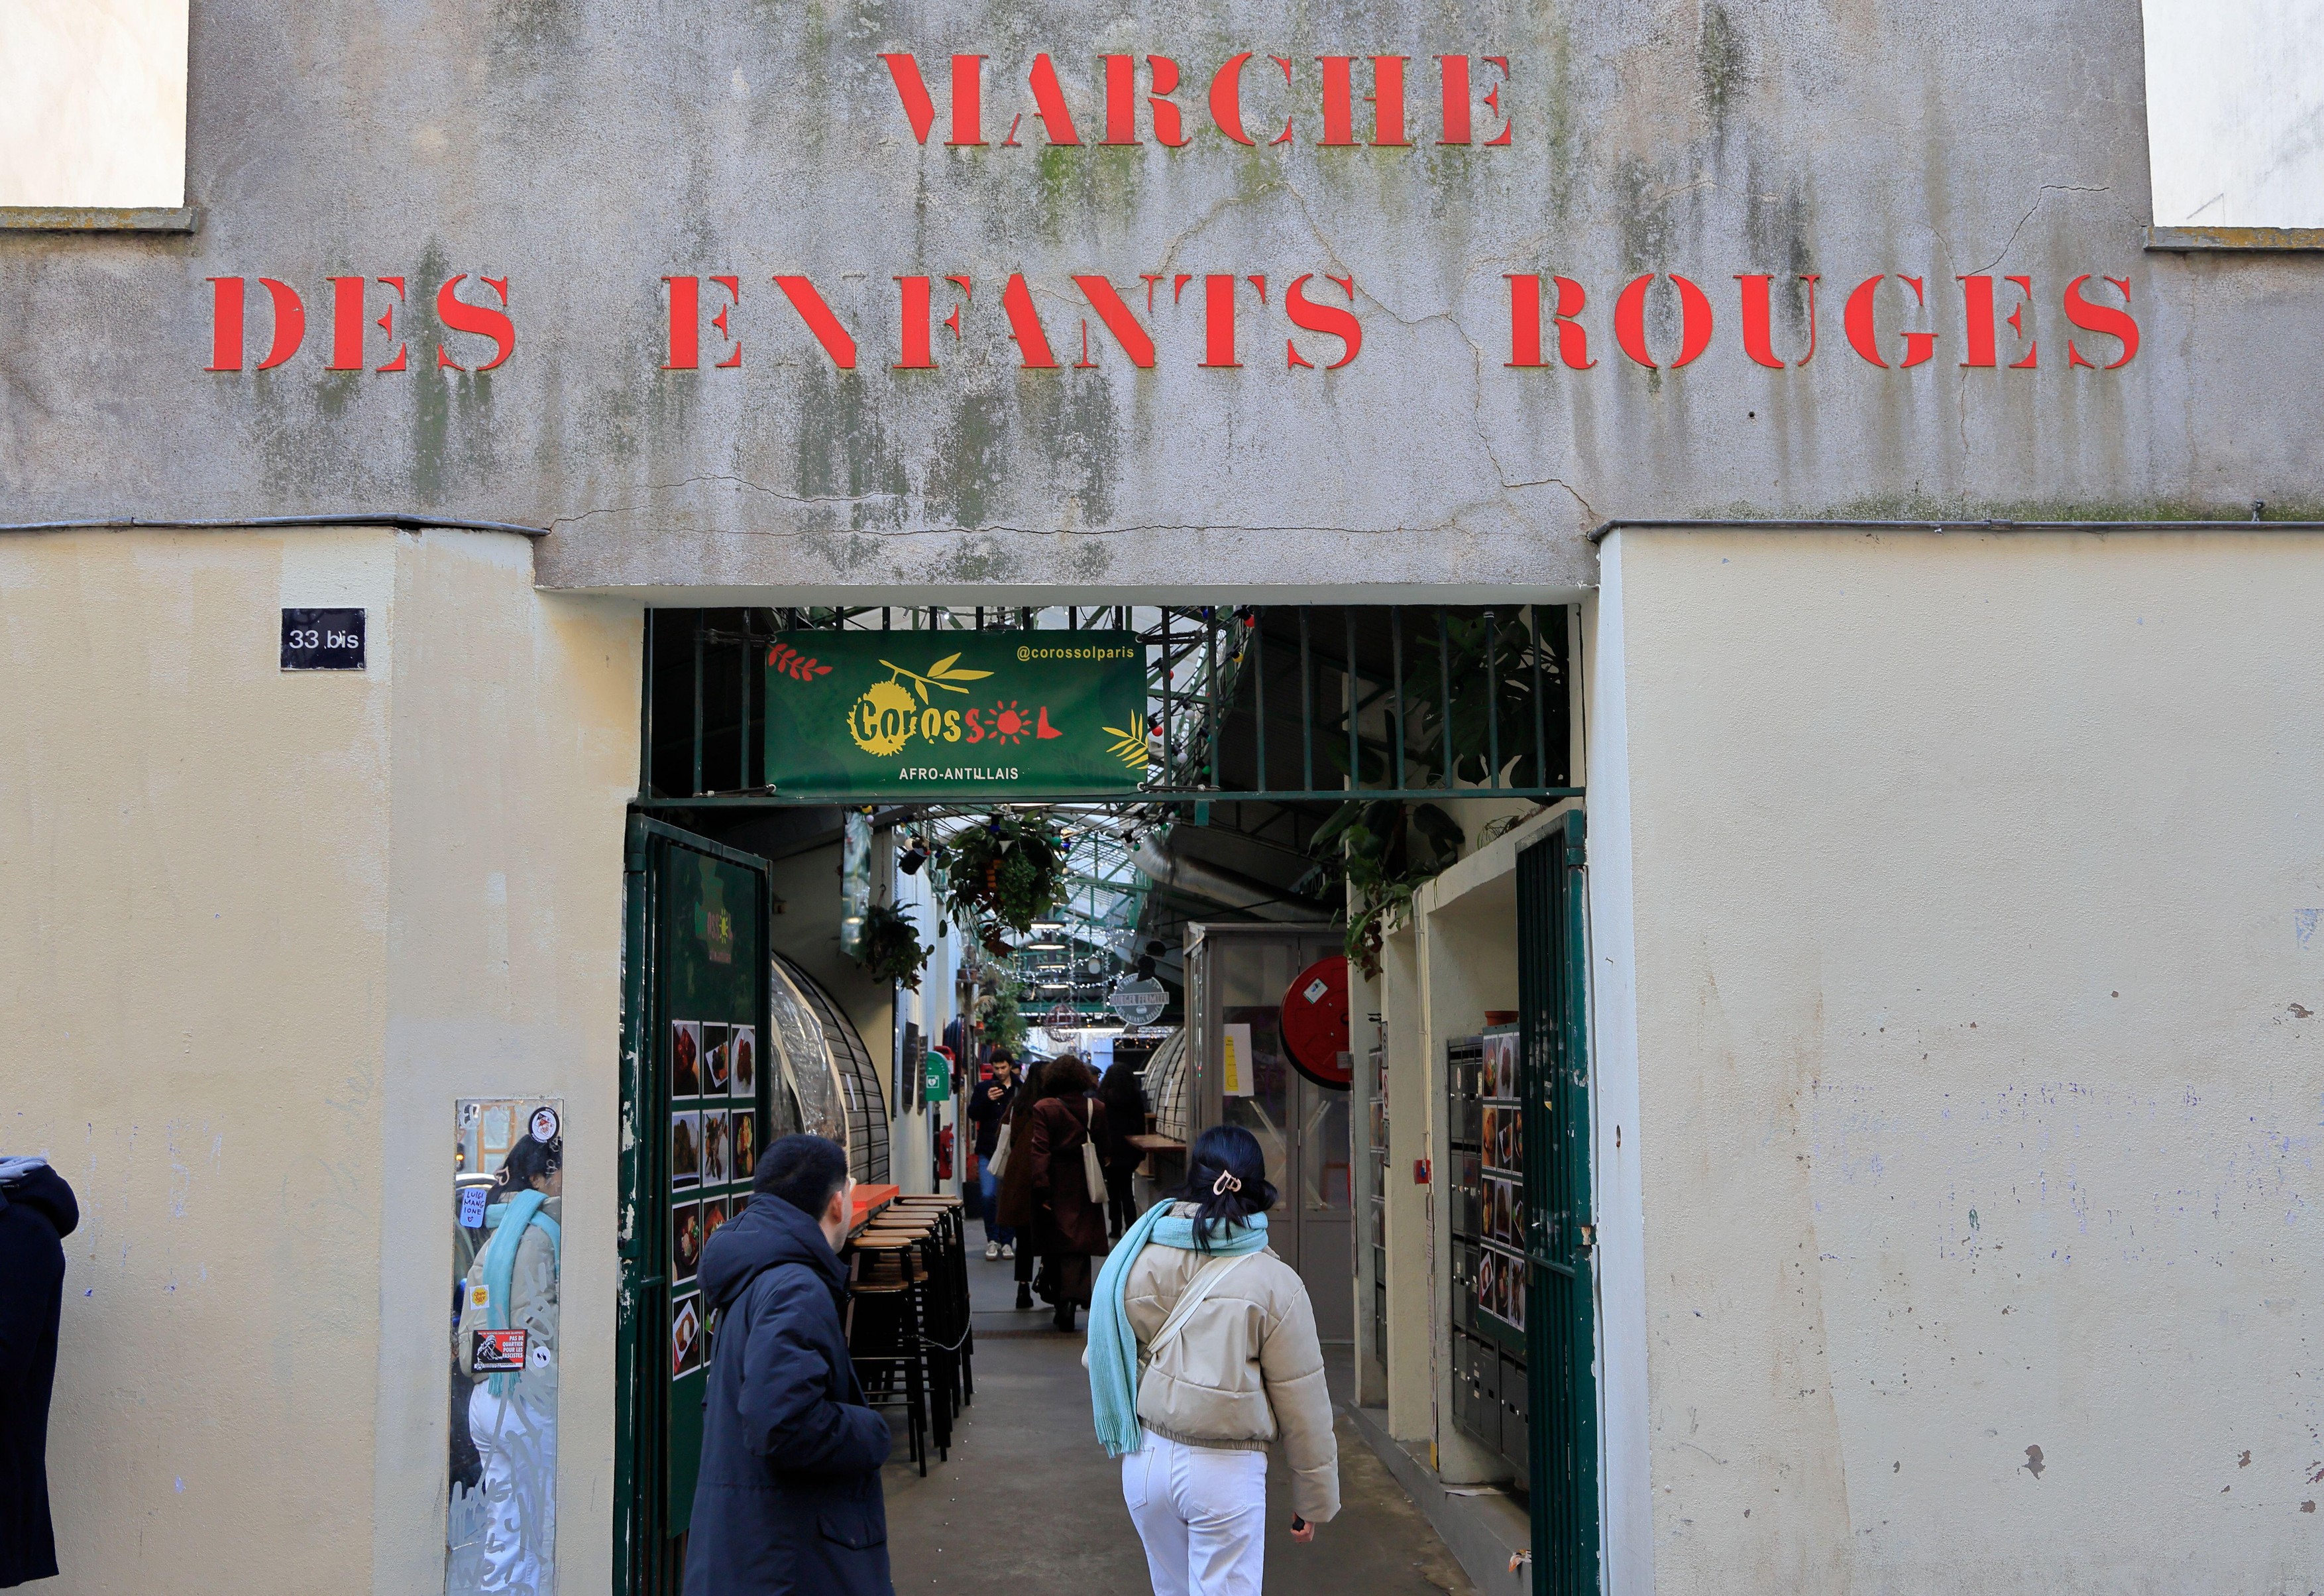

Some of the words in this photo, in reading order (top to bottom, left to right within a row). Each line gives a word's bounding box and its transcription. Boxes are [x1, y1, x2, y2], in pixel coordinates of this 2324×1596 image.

[878, 52, 1512, 146] MARCHE
[205, 274, 514, 371] DES
[661, 274, 1362, 369] ENFANTS
[1504, 273, 2140, 370] ROUGES
[289, 630, 319, 649] 33
[327, 630, 359, 649] bis
[1017, 646, 1134, 661] @corossolparis
[899, 768, 1019, 780] AFRO-ANTILLAIS
[464, 1198, 485, 1208] MANG
